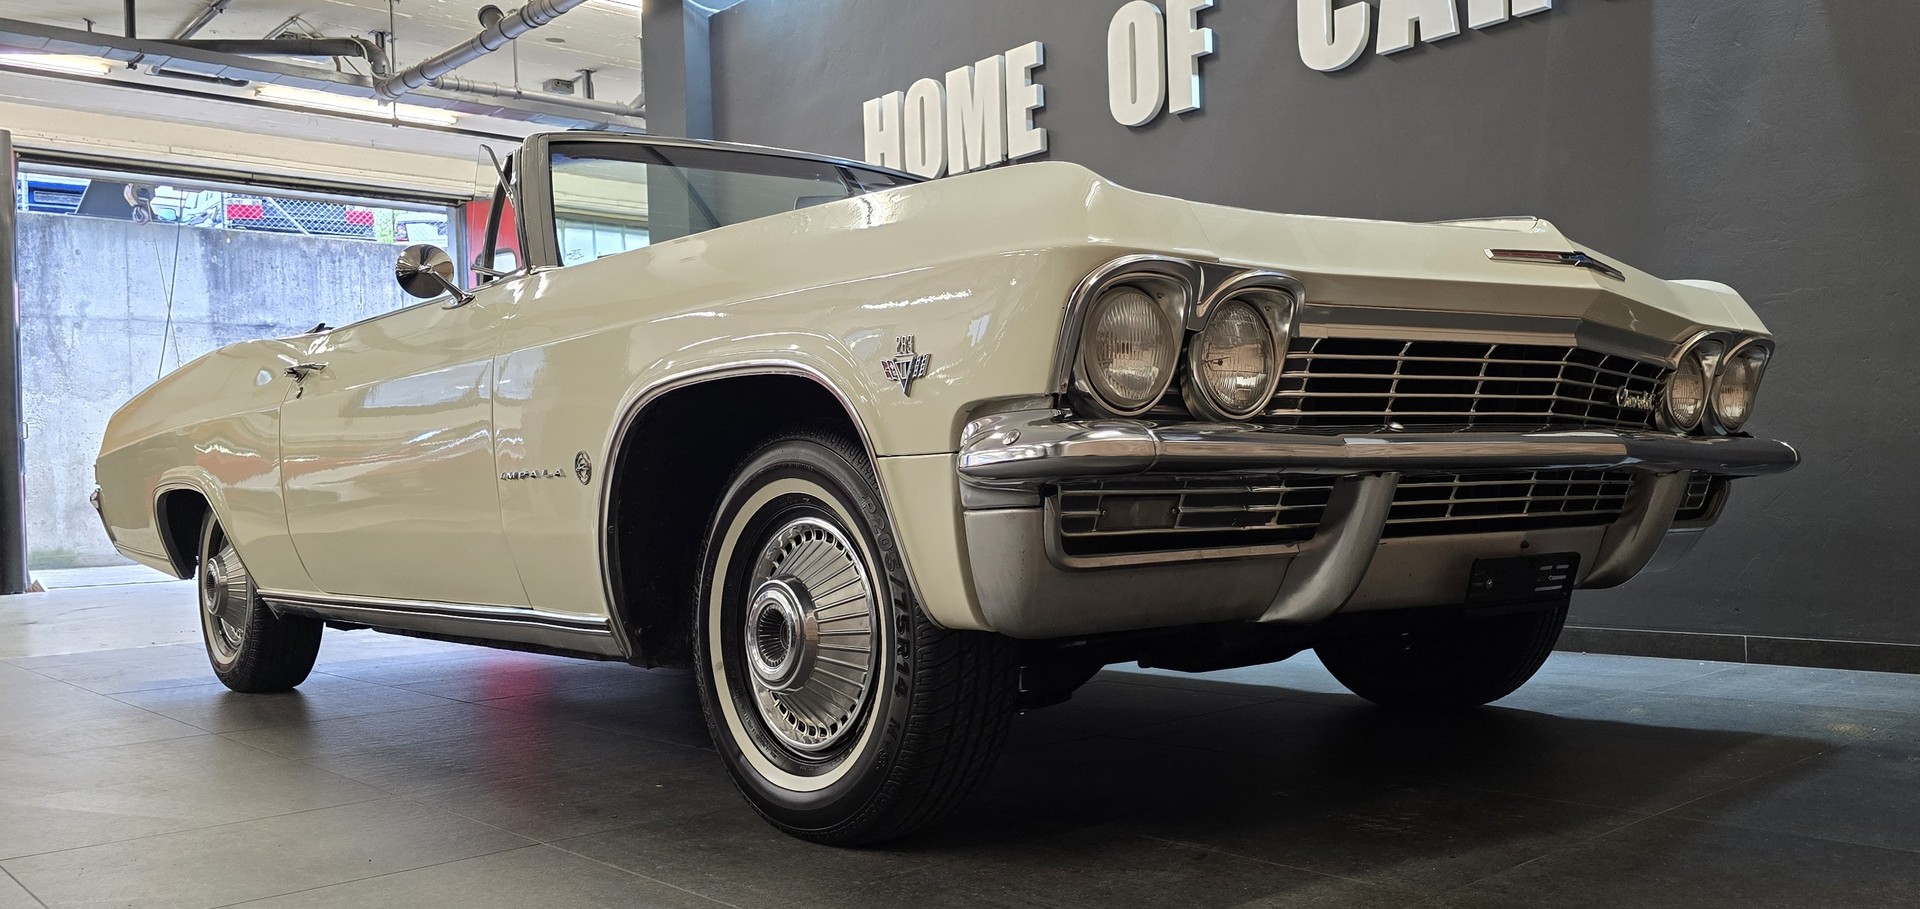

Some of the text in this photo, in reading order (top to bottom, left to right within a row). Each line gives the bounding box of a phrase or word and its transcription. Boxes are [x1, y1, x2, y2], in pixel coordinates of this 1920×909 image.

[863, 41, 1048, 179] HOME
[1107, 0, 1213, 126] OF
[500, 468, 566, 481] IMPALA
